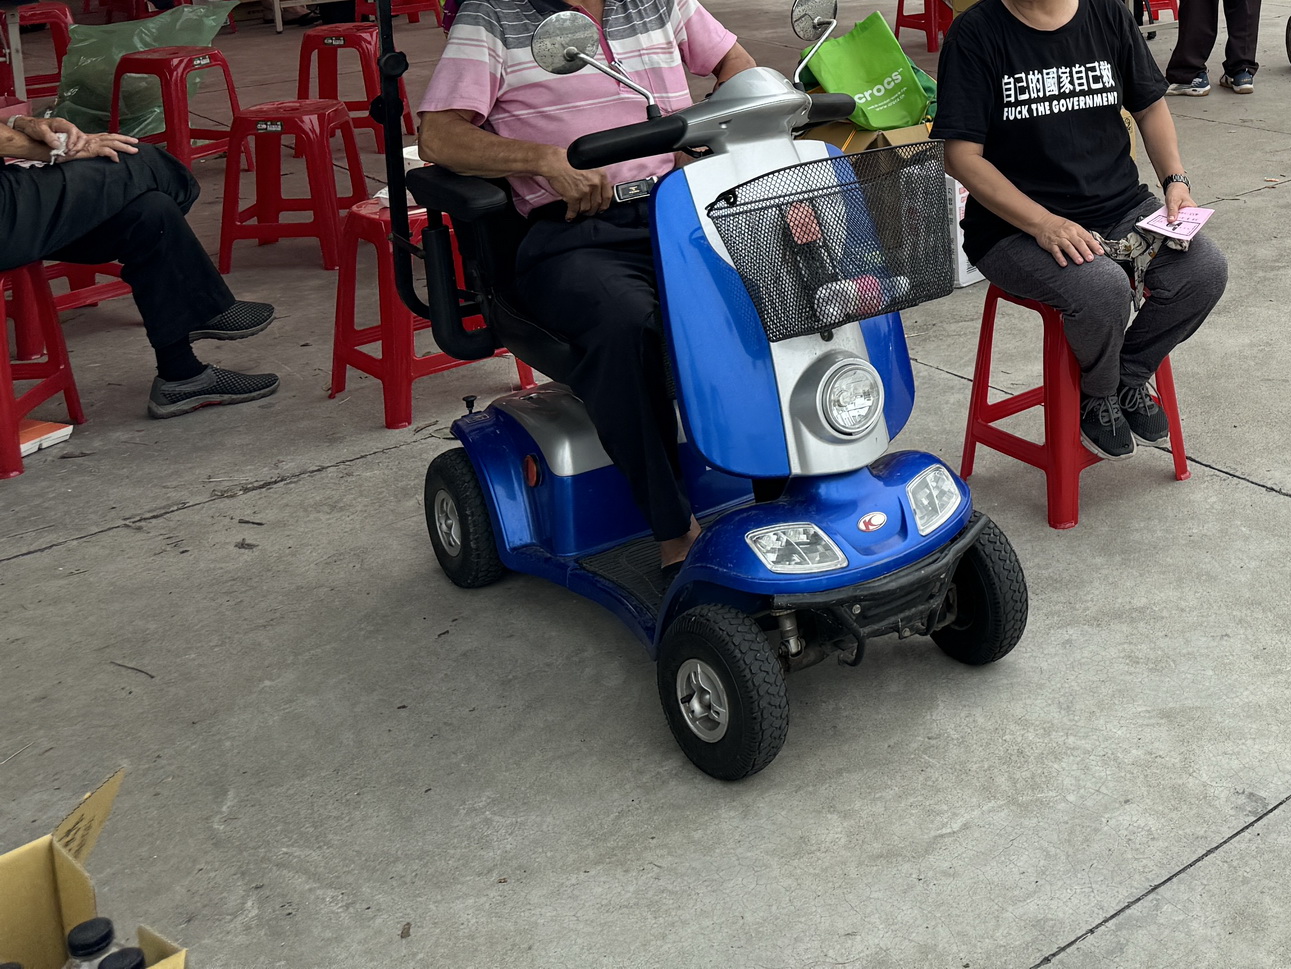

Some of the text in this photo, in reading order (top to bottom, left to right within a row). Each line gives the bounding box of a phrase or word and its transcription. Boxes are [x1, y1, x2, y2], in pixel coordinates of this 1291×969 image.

[854, 71, 902, 104] crocs
[1002, 60, 1116, 104] 自己的國家自己救
[1003, 91, 1118, 121] FUCK THE GOVERNMENT
